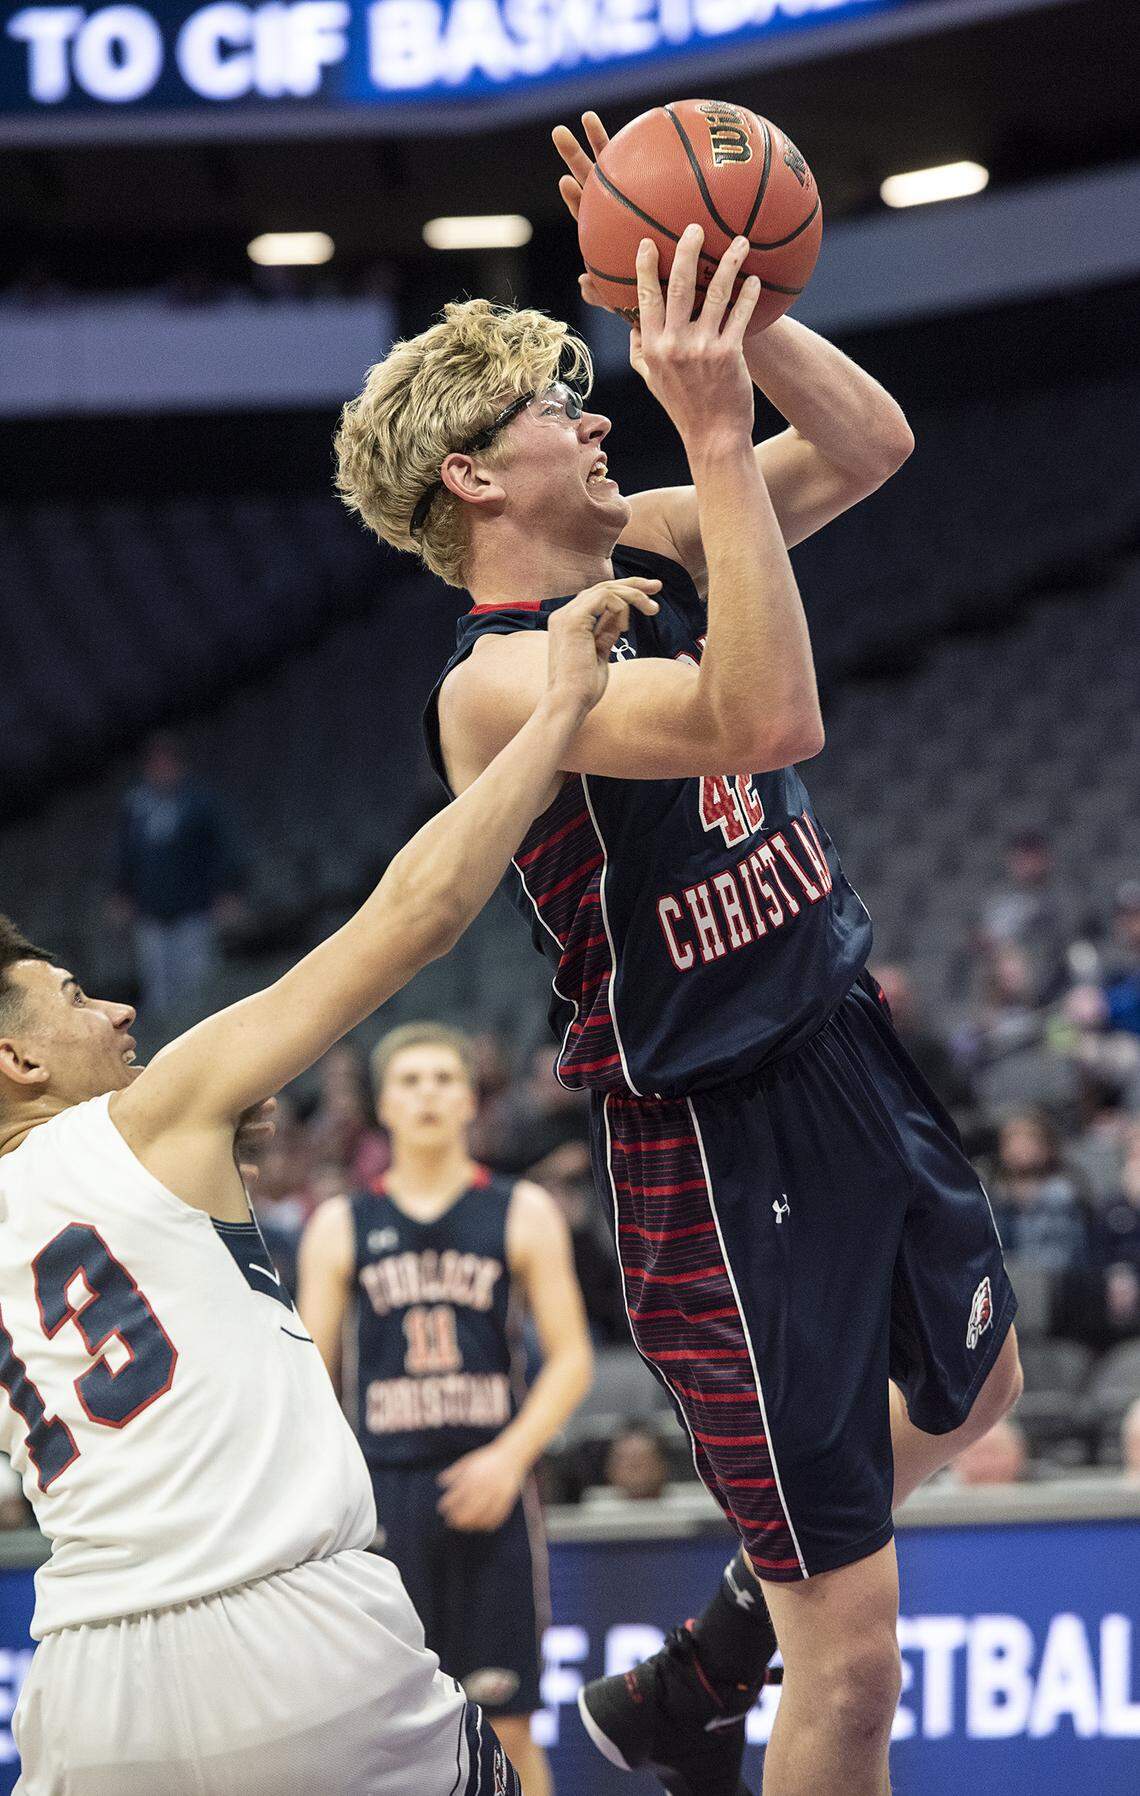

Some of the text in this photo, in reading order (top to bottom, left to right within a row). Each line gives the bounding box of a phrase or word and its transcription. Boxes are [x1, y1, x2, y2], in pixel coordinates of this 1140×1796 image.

[6, 3, 164, 103] TO
[175, 0, 350, 101] CIF
[0, 1221, 179, 1494] 13
[402, 1303, 464, 1377] 11
